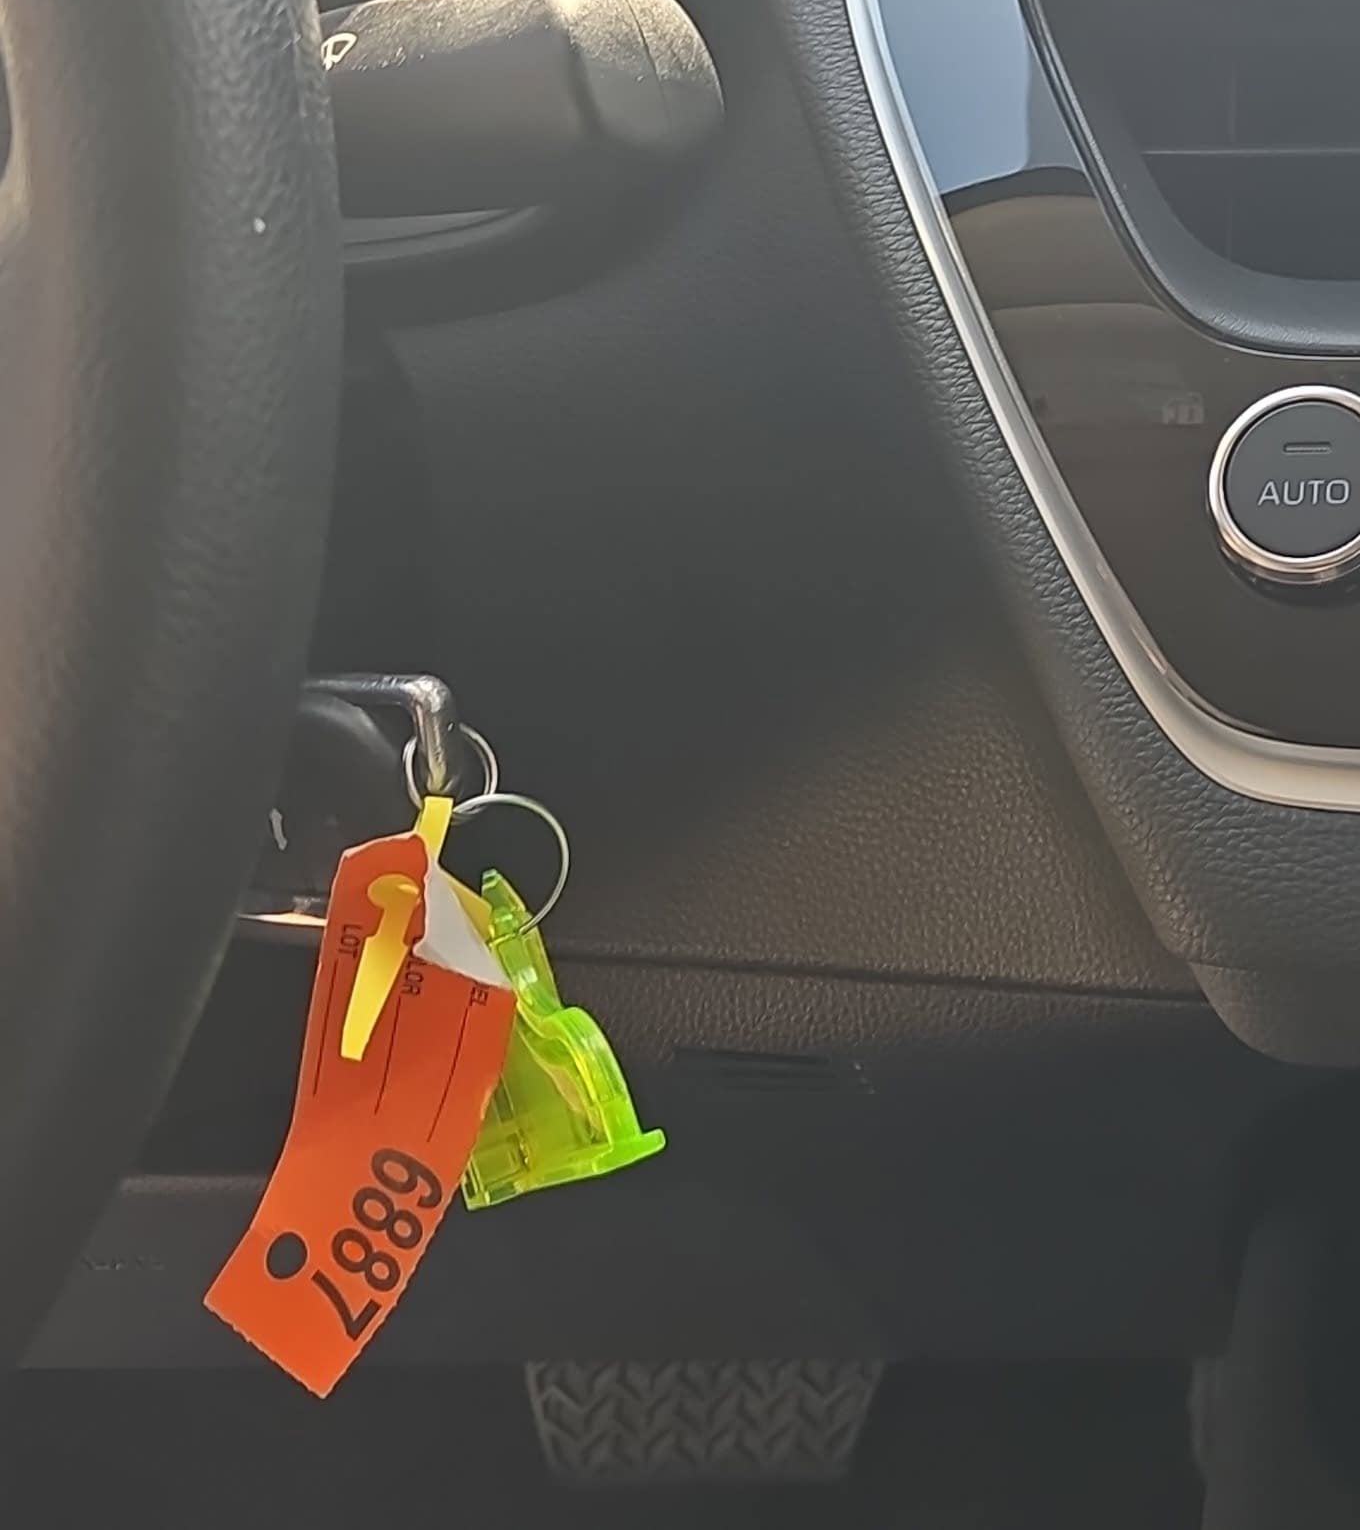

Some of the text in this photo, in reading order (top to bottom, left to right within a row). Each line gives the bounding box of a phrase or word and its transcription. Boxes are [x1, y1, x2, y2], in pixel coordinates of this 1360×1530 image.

[1256, 477, 1352, 509] AUTO
[338, 923, 363, 958] LOT
[310, 1146, 445, 1343] 6887
